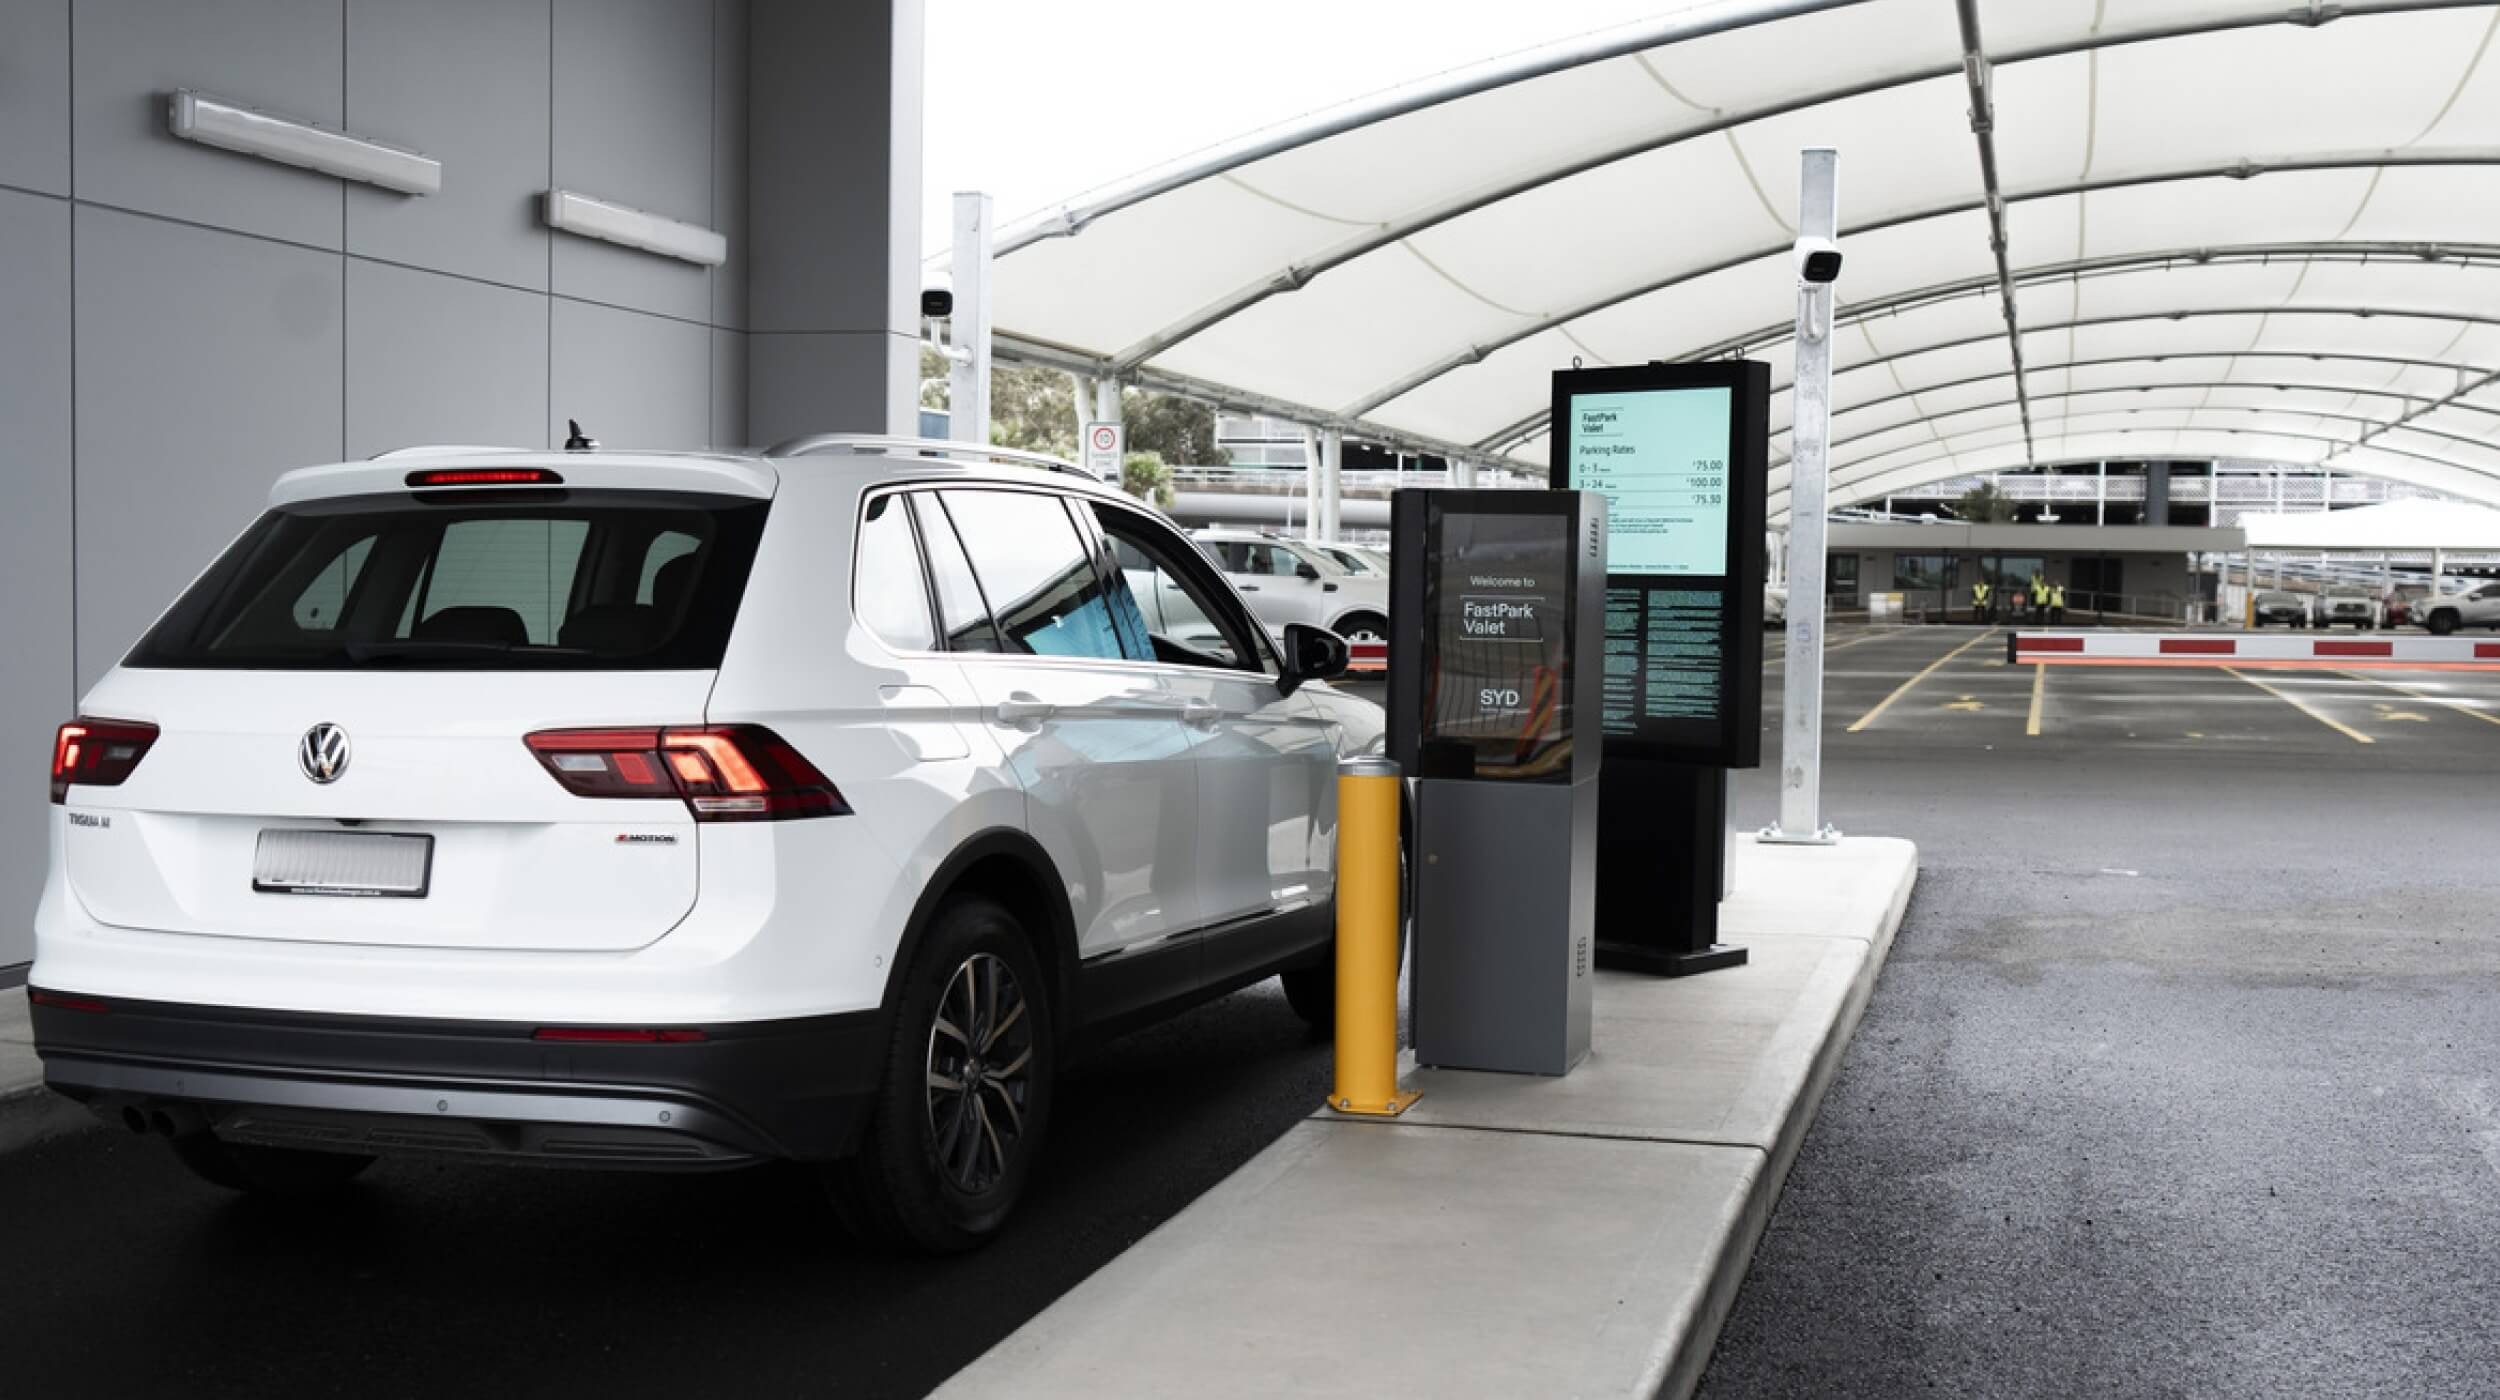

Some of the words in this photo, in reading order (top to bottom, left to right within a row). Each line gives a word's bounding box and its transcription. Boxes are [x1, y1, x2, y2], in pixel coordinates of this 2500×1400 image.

[1583, 412, 1617, 422] FastPark
[1582, 423, 1603, 433] Valet
[1579, 444, 1610, 457] Parking
[1612, 444, 1636, 455] Rates
[1470, 576, 1521, 588] Welcome
[1524, 577, 1536, 588] to
[1464, 602, 1534, 618] FastPark
[1464, 619, 1506, 635] Valet
[1480, 688, 1520, 706] SYD
